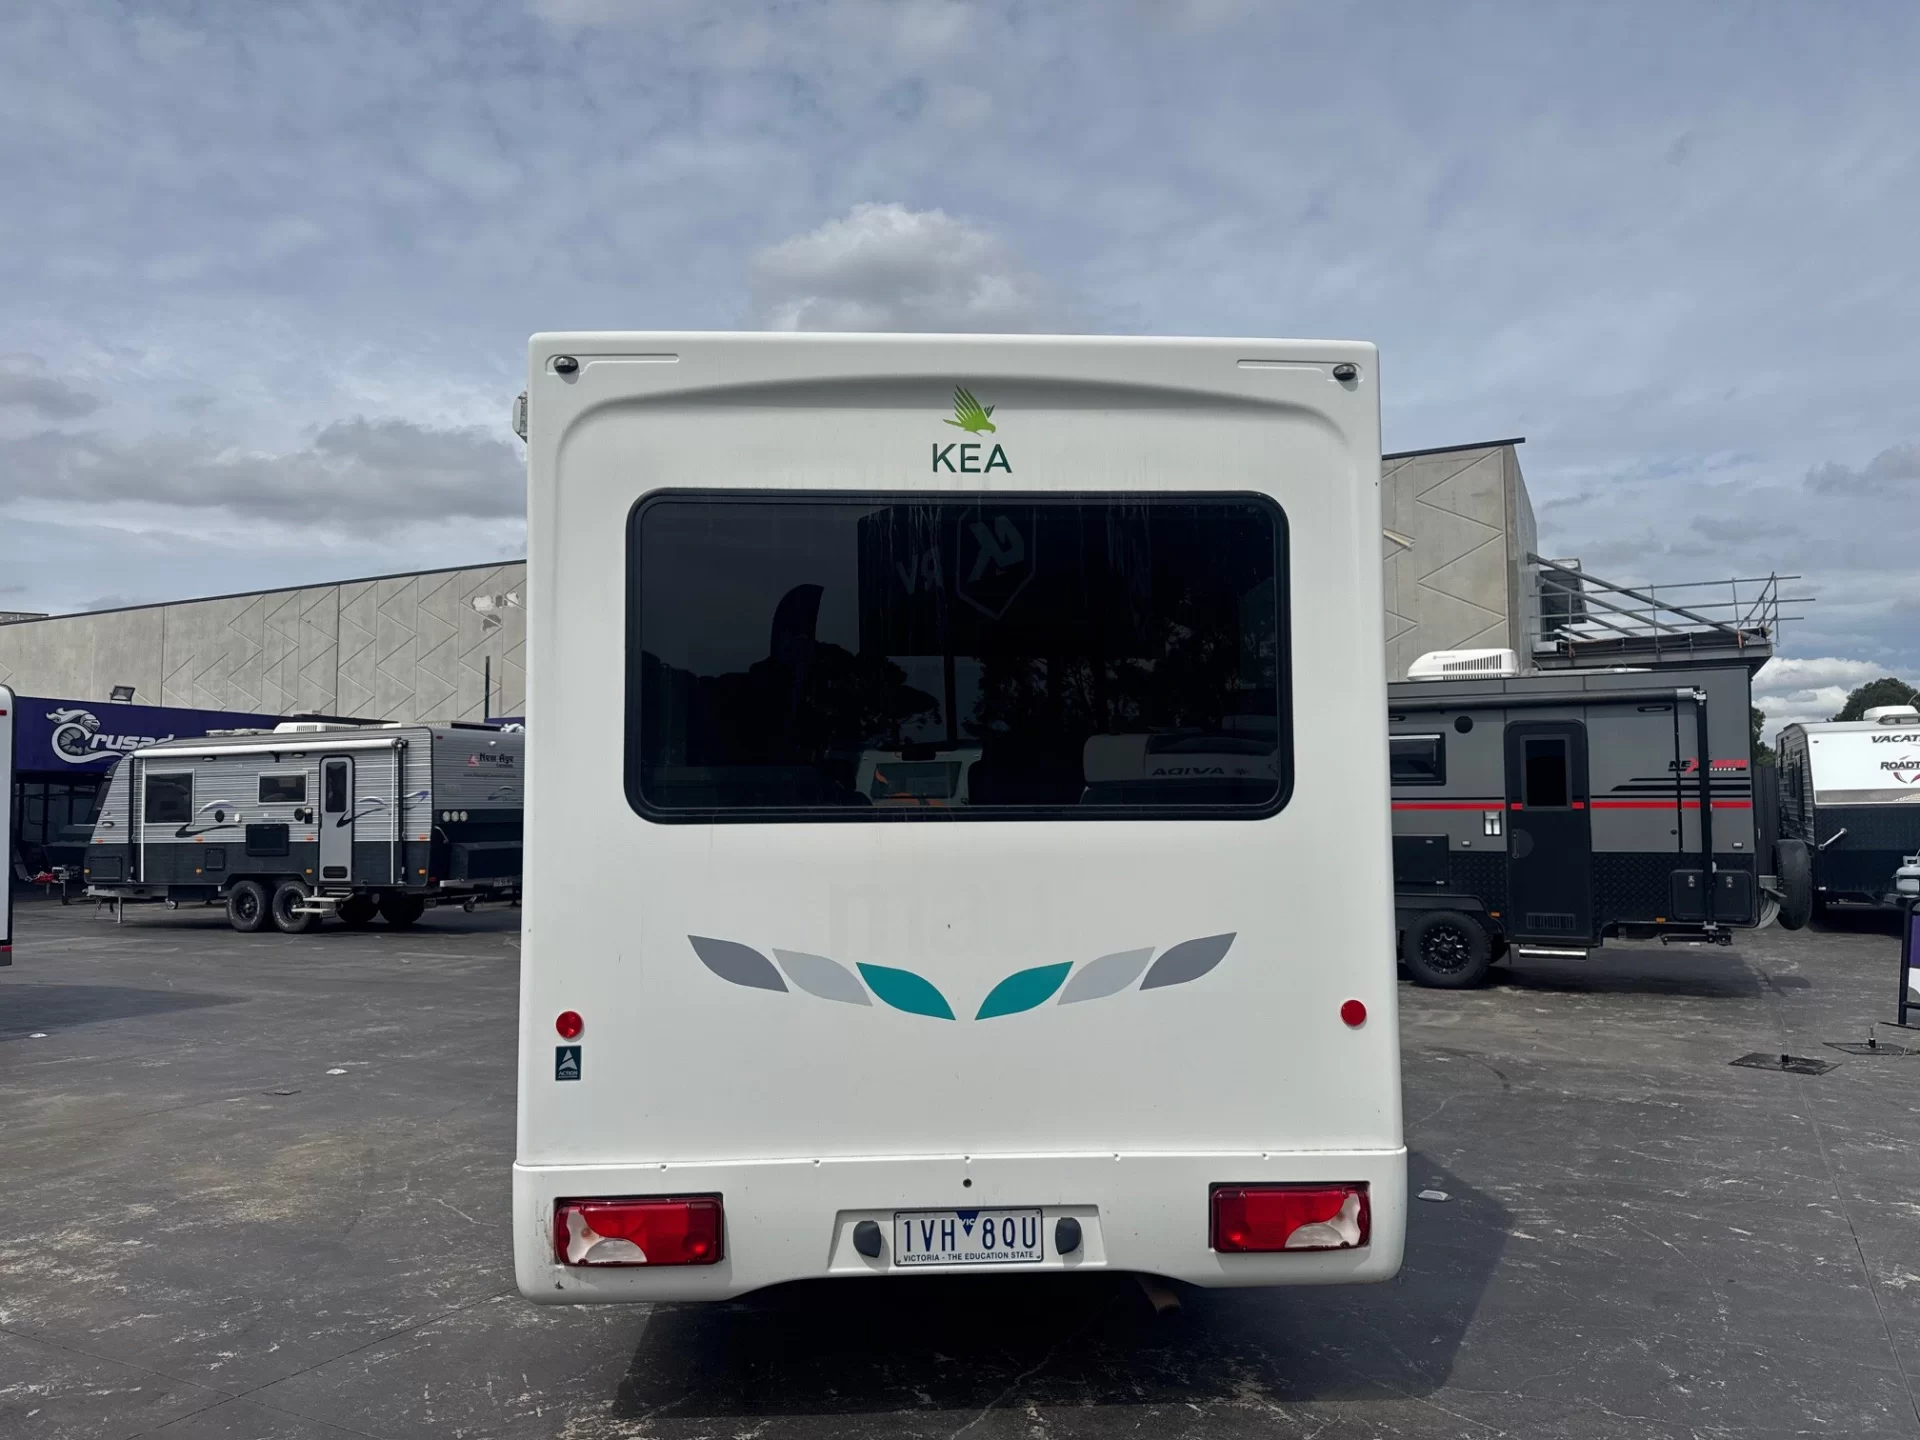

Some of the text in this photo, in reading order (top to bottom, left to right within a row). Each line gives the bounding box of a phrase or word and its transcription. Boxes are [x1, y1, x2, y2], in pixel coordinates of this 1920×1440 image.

[932, 443, 1012, 473] KEA
[961, 1218, 975, 1226] VIC
[904, 1217, 1036, 1252] 1VH 8QU
[903, 1254, 940, 1262] VICTORIA
[964, 1251, 1009, 1260] EDUCATION
[1010, 1250, 1034, 1259] STATE
